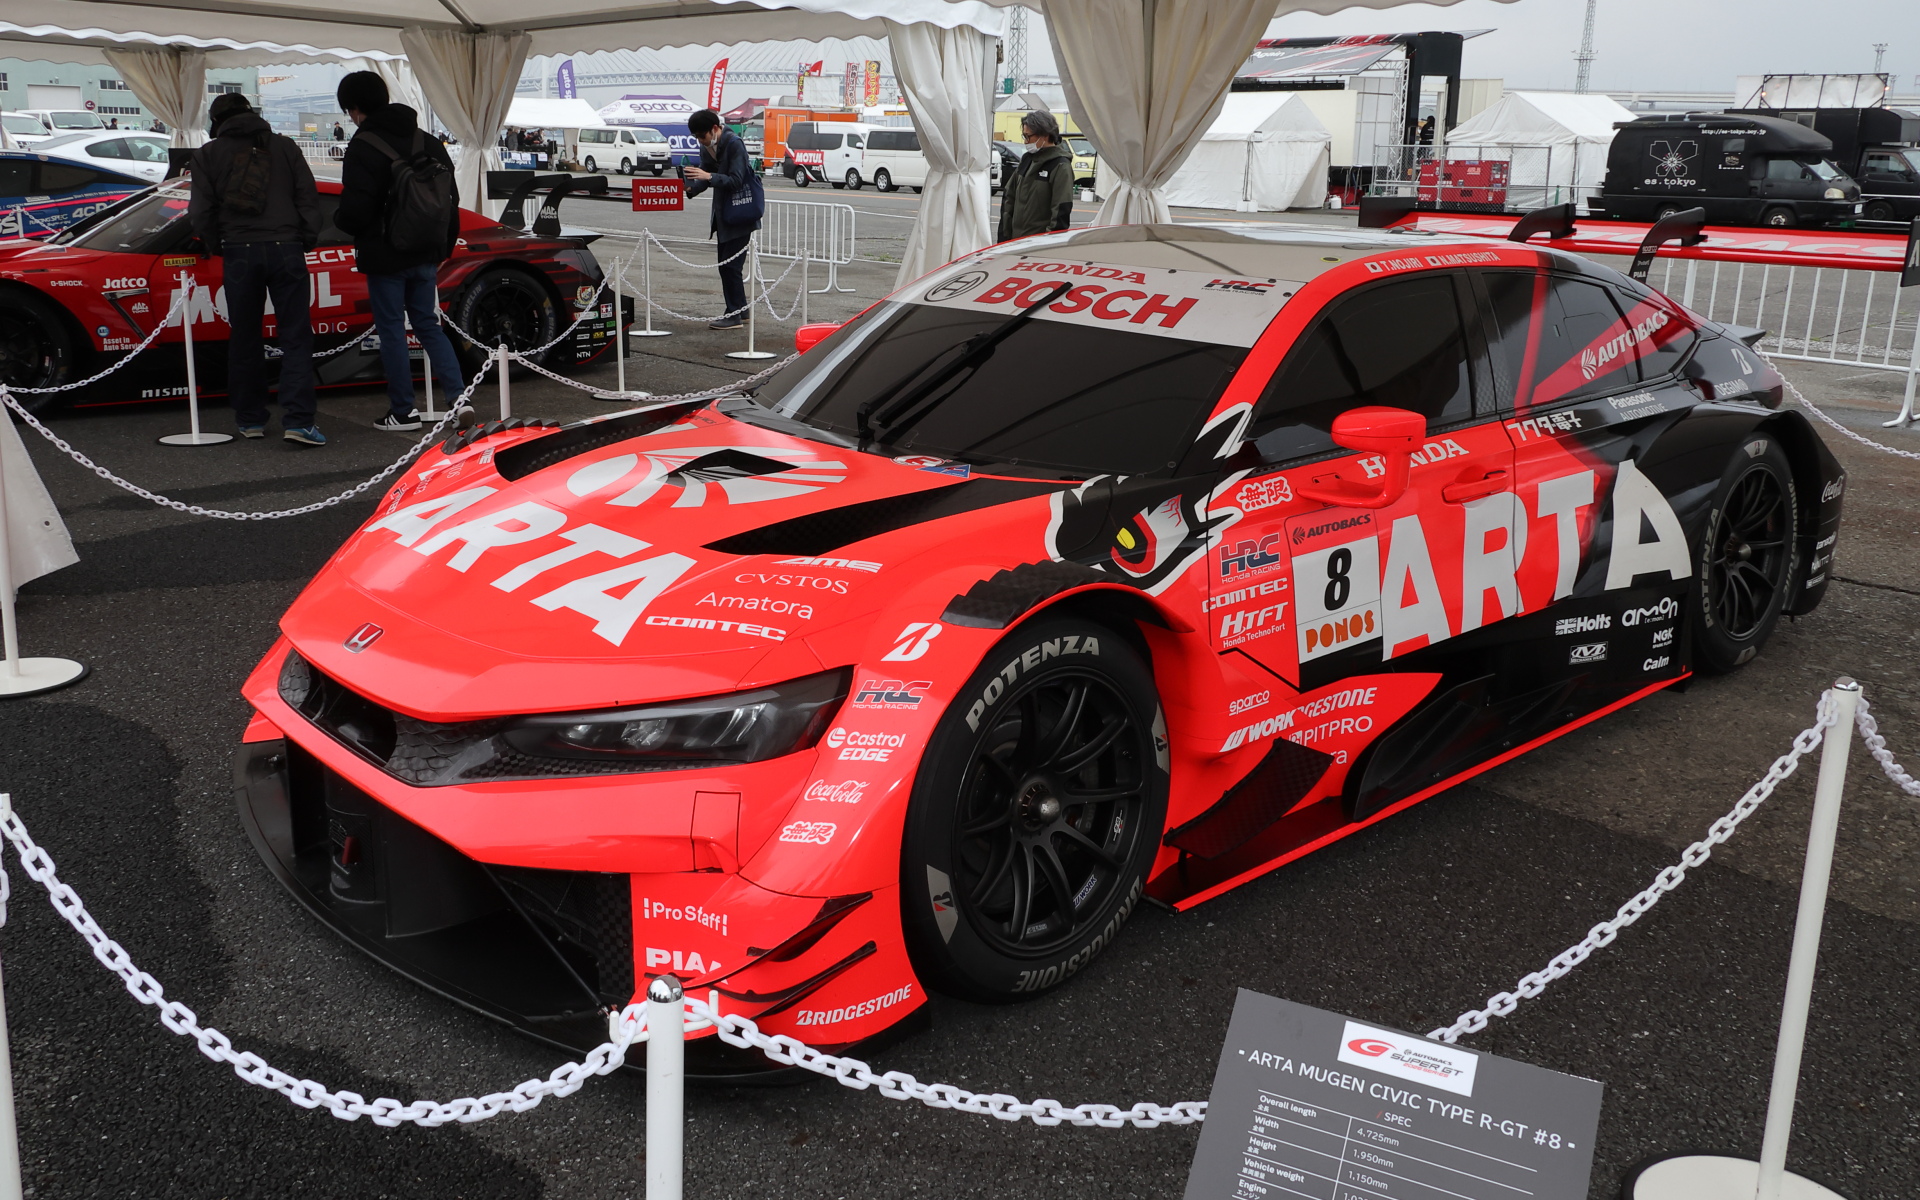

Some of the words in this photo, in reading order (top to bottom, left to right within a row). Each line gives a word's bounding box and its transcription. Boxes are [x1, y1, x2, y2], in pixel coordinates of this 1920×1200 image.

[711, 68, 725, 108] MOTUL
[630, 102, 693, 114] sparco
[796, 152, 822, 164] MOTUL
[1644, 178, 1696, 187] es.tokyo
[1380, 258, 1424, 272] T.NOJIRI
[1438, 252, 1501, 266] N.MATSUSHITA
[102, 277, 147, 289] Jatco
[1006, 262, 1146, 285] HONDA
[1204, 279, 1276, 293] HRC
[973, 277, 1199, 328] BOSCH
[1598, 308, 1669, 367] AUTOBACS
[1607, 390, 1655, 410] Panasonic
[1620, 402, 1668, 421] AUTOMOTIVE
[1236, 476, 1294, 512] 無限
[1307, 514, 1371, 538] AUTOBACS
[363, 485, 698, 647] ARTA
[1220, 533, 1280, 577] HRC
[1382, 458, 1692, 662] ARTA
[1222, 572, 1250, 584] Honda
[1251, 564, 1281, 577] RACING
[1323, 548, 1352, 612] 8
[1702, 508, 1719, 628] POTENZA
[734, 574, 850, 594] CVSTOS
[1202, 577, 1288, 613] COMTEC
[695, 592, 814, 620] Amatora
[1622, 597, 1678, 627] amon
[645, 616, 787, 642] COMTEC
[1306, 610, 1374, 653] PONOS
[1576, 614, 1612, 632] Holts
[1652, 626, 1674, 644] NGK
[1222, 636, 1246, 648] Honda
[1642, 656, 1670, 672] Calm
[854, 680, 932, 704] HRC
[965, 635, 1100, 734] POTENZA
[1228, 690, 1270, 716] sparco
[1248, 708, 1297, 742] WORK
[1304, 716, 1373, 746] PITPRO
[846, 731, 906, 748] Castrol
[838, 748, 894, 762] EDGE
[804, 779, 870, 804] Coca-Cola
[779, 821, 837, 845] 無限
[1012, 874, 1144, 993] BRIDGESTONE
[796, 984, 912, 1026] BRIDGESTONE
[1390, 1052, 1440, 1070] SUPER
[1441, 1066, 1464, 1076] GT
[1412, 1052, 1452, 1066] AUTOBACS
[1248, 1050, 1294, 1074] ARTA
[1298, 1062, 1366, 1094] MUGEN
[1370, 1082, 1422, 1109] CIVIC
[1427, 1098, 1475, 1125] TYPE
[1480, 1113, 1529, 1139] R-GT
[1532, 1128, 1562, 1150] #8
[1259, 1094, 1290, 1112] Overall
[1290, 1104, 1318, 1118] length
[1254, 1115, 1280, 1130] Width
[1384, 1112, 1412, 1128] SPEC
[1249, 1136, 1278, 1152] Height
[1356, 1128, 1400, 1147] 4,725mm
[1352, 1148, 1394, 1168] 1,950mm
[1244, 1157, 1275, 1174] Vehicle
[1276, 1168, 1305, 1184] weight
[1348, 1170, 1388, 1190] 1,150mm
[1236, 1188, 1260, 1200] エンジン
[1238, 1178, 1267, 1195] Engine
